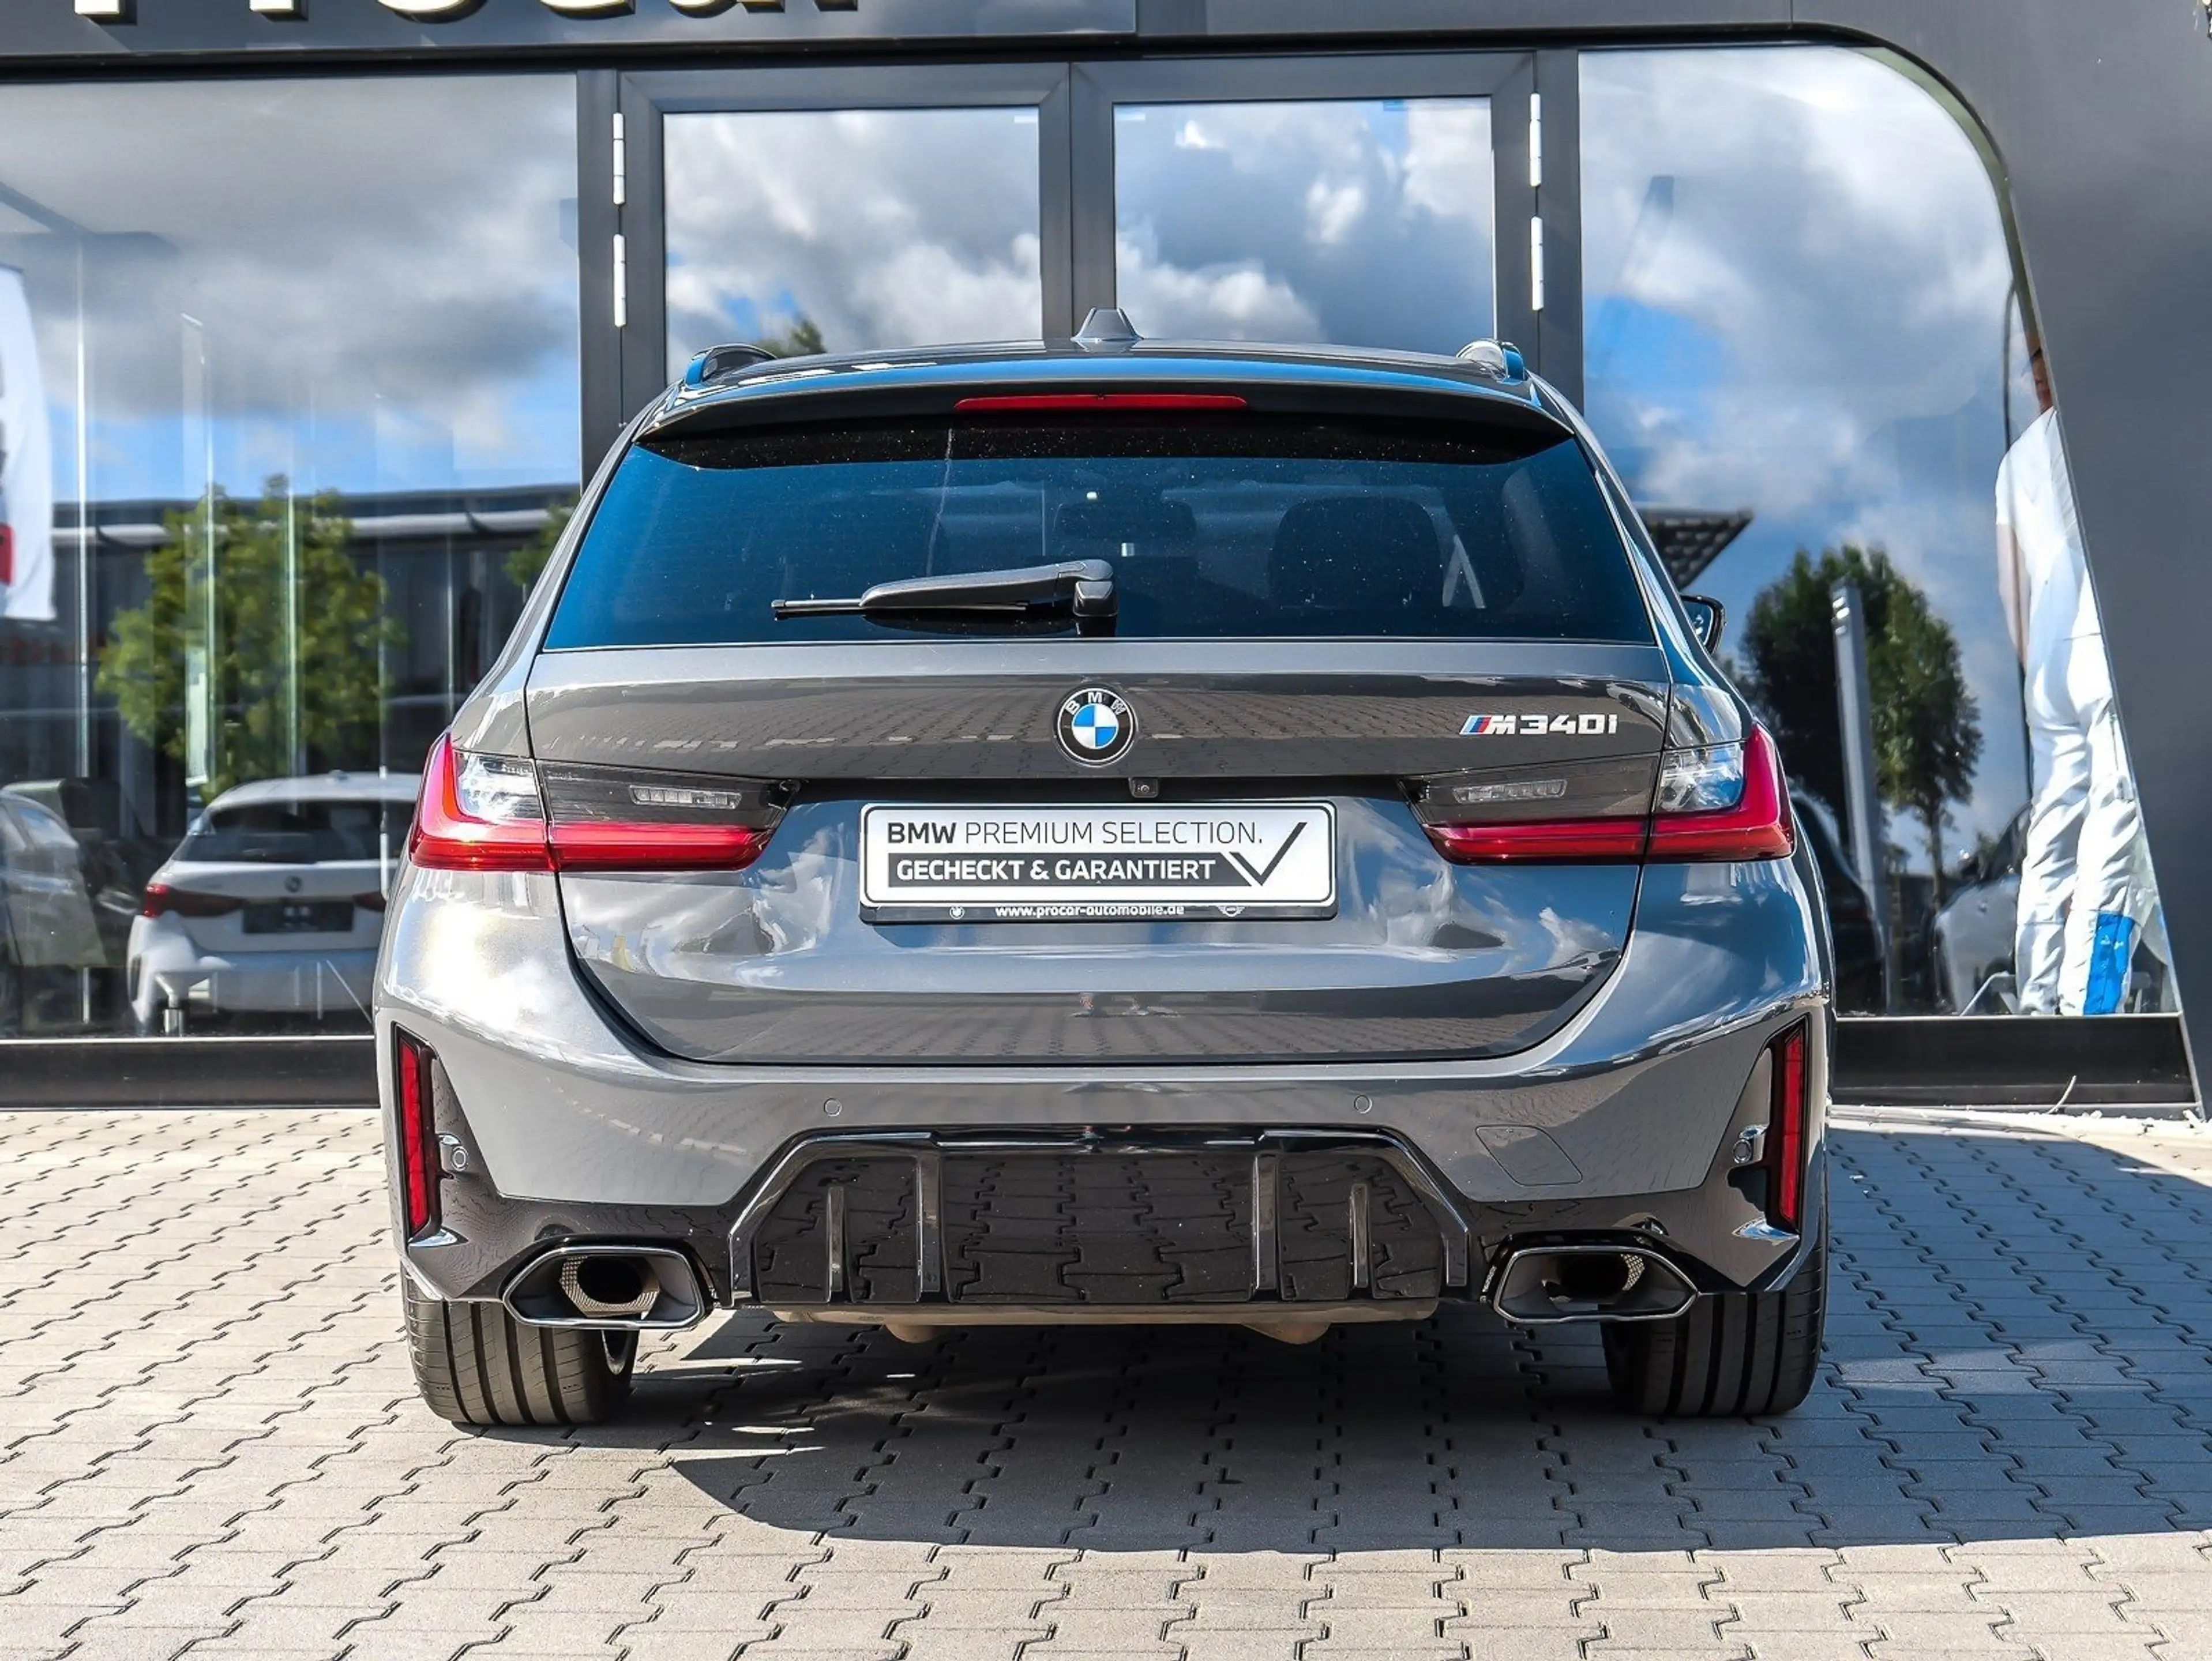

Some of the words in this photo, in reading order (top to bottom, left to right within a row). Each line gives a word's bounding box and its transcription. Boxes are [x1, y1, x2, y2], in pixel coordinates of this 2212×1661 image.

[1065, 692, 1126, 715] BMW
[888, 822, 956, 844] BMW
[966, 821, 1092, 844] PREMIUM
[1102, 821, 1262, 844] SELECTION.
[897, 859, 1025, 880] GECHECKT
[1030, 859, 1050, 880] &
[1055, 859, 1216, 880] GARANTIERT
[995, 905, 1185, 918] www.procar-automobile.de
